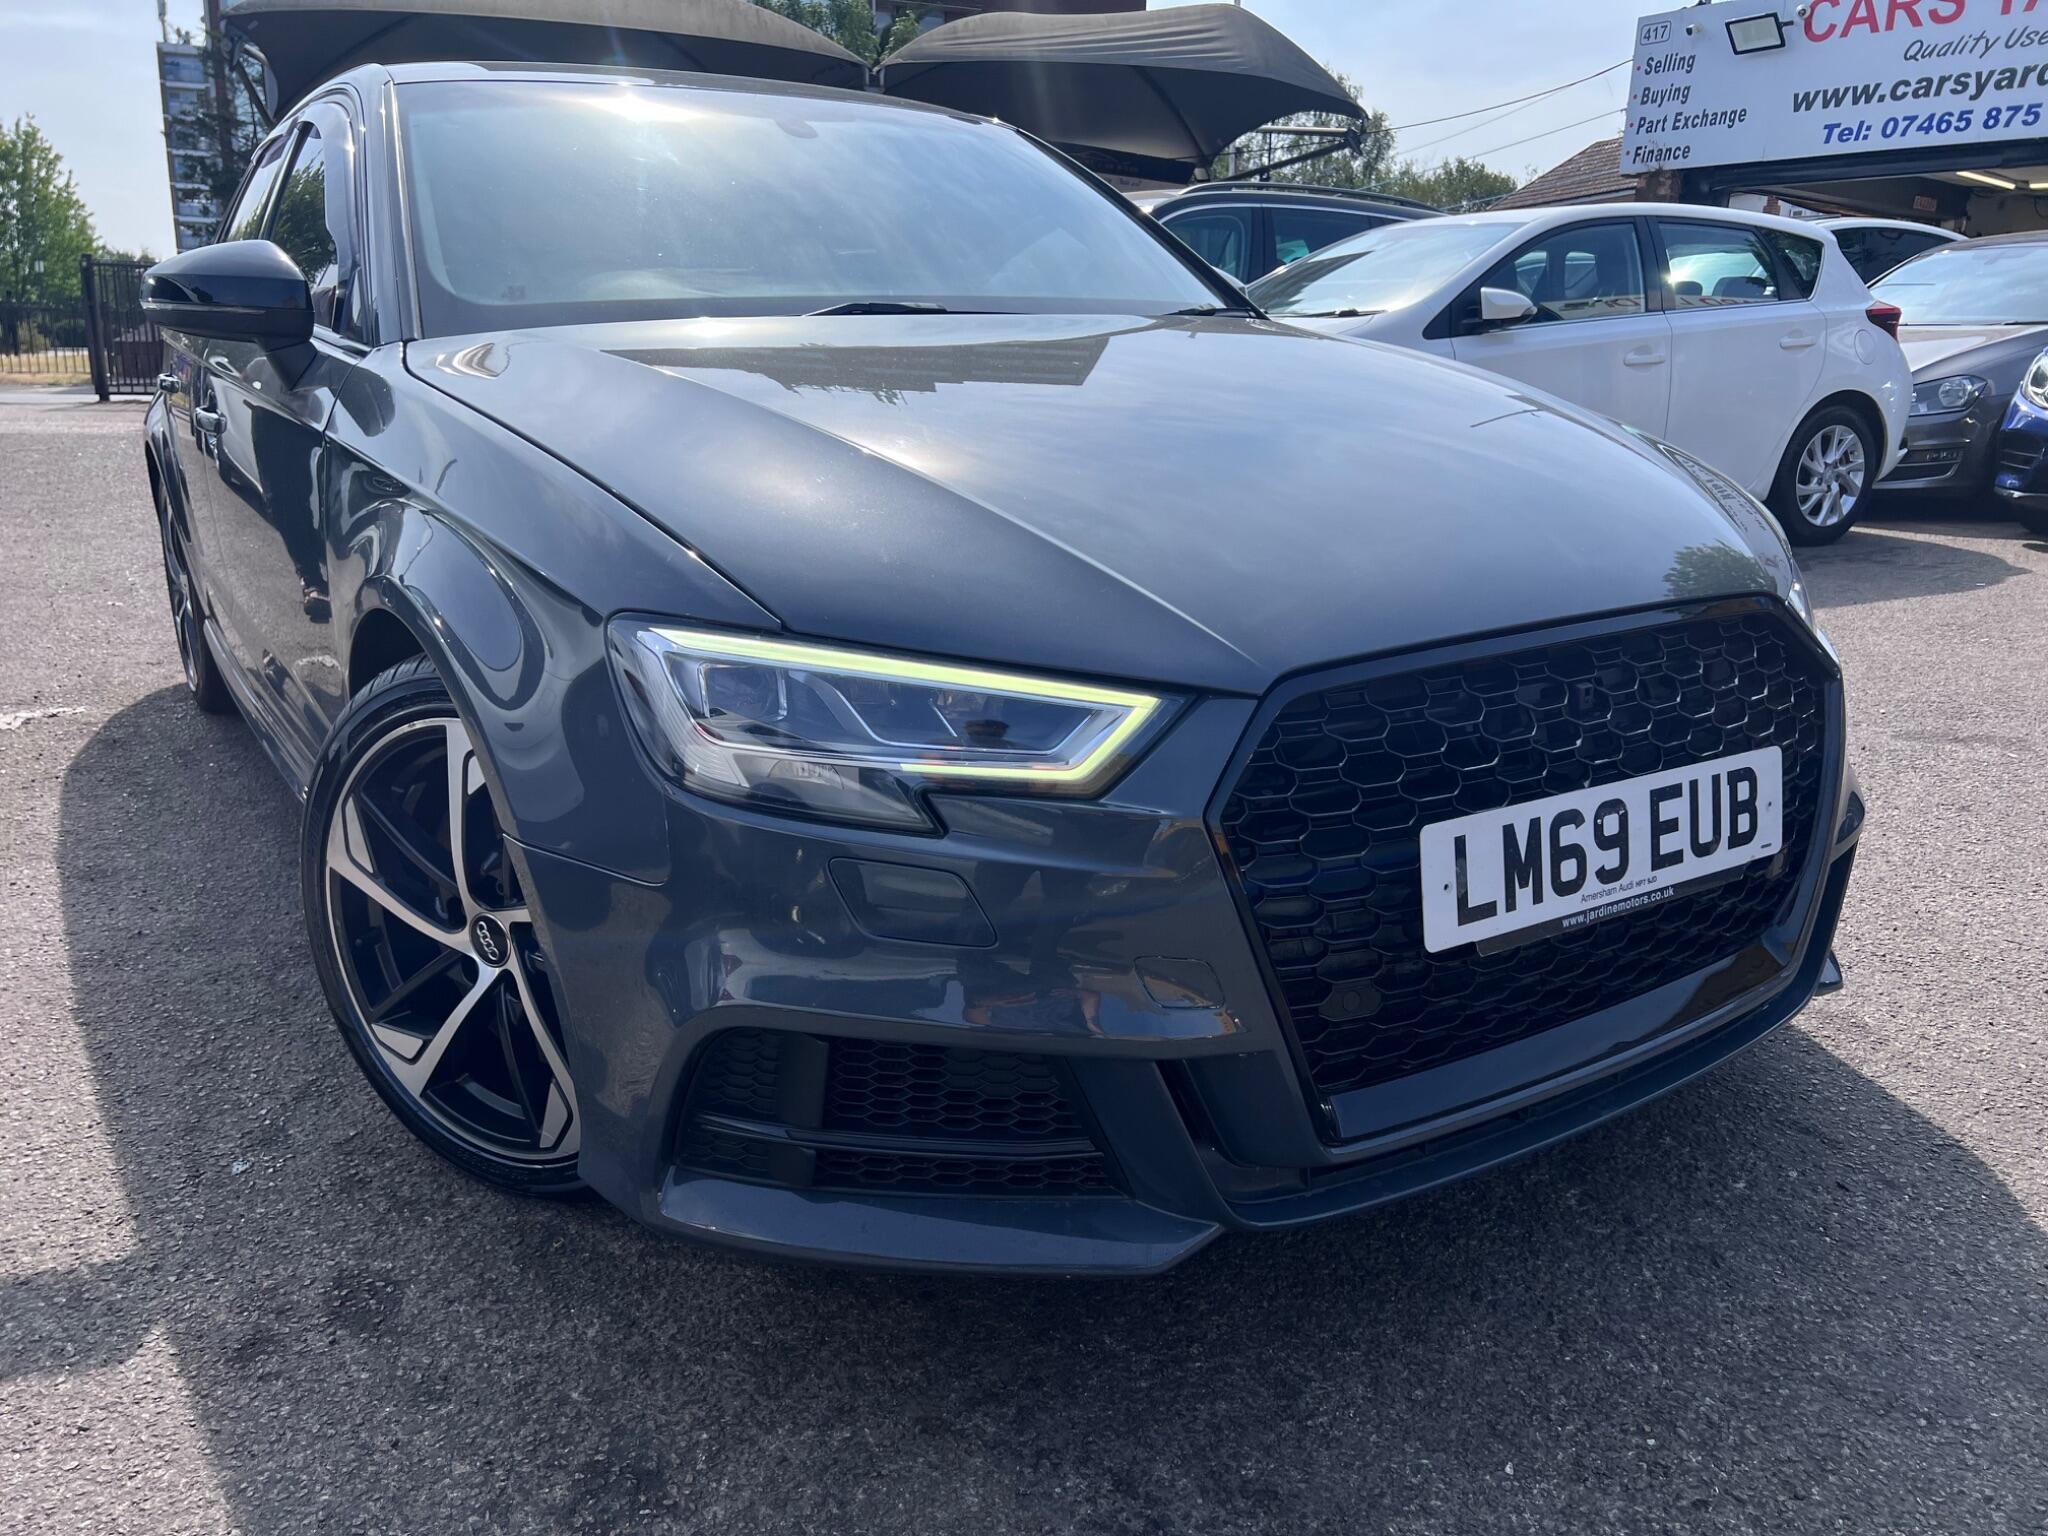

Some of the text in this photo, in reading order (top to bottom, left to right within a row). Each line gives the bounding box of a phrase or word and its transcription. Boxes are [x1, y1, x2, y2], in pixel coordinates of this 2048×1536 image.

[1643, 25, 1668, 41] 417
[1903, 30, 2001, 61] Quality
[1644, 53, 1697, 76] Selling
[1640, 83, 1692, 107] Buying
[1635, 108, 1747, 135] Part Exchange
[1822, 103, 2043, 144] Tel: 07465 875
[1632, 144, 1691, 164] Finance
[1453, 765, 1759, 928] LM69 EUB
[1581, 886, 1618, 904] Amersham
[1618, 880, 1634, 893] Audi
[1562, 886, 1675, 928] www.jardinemotors.co.uk
